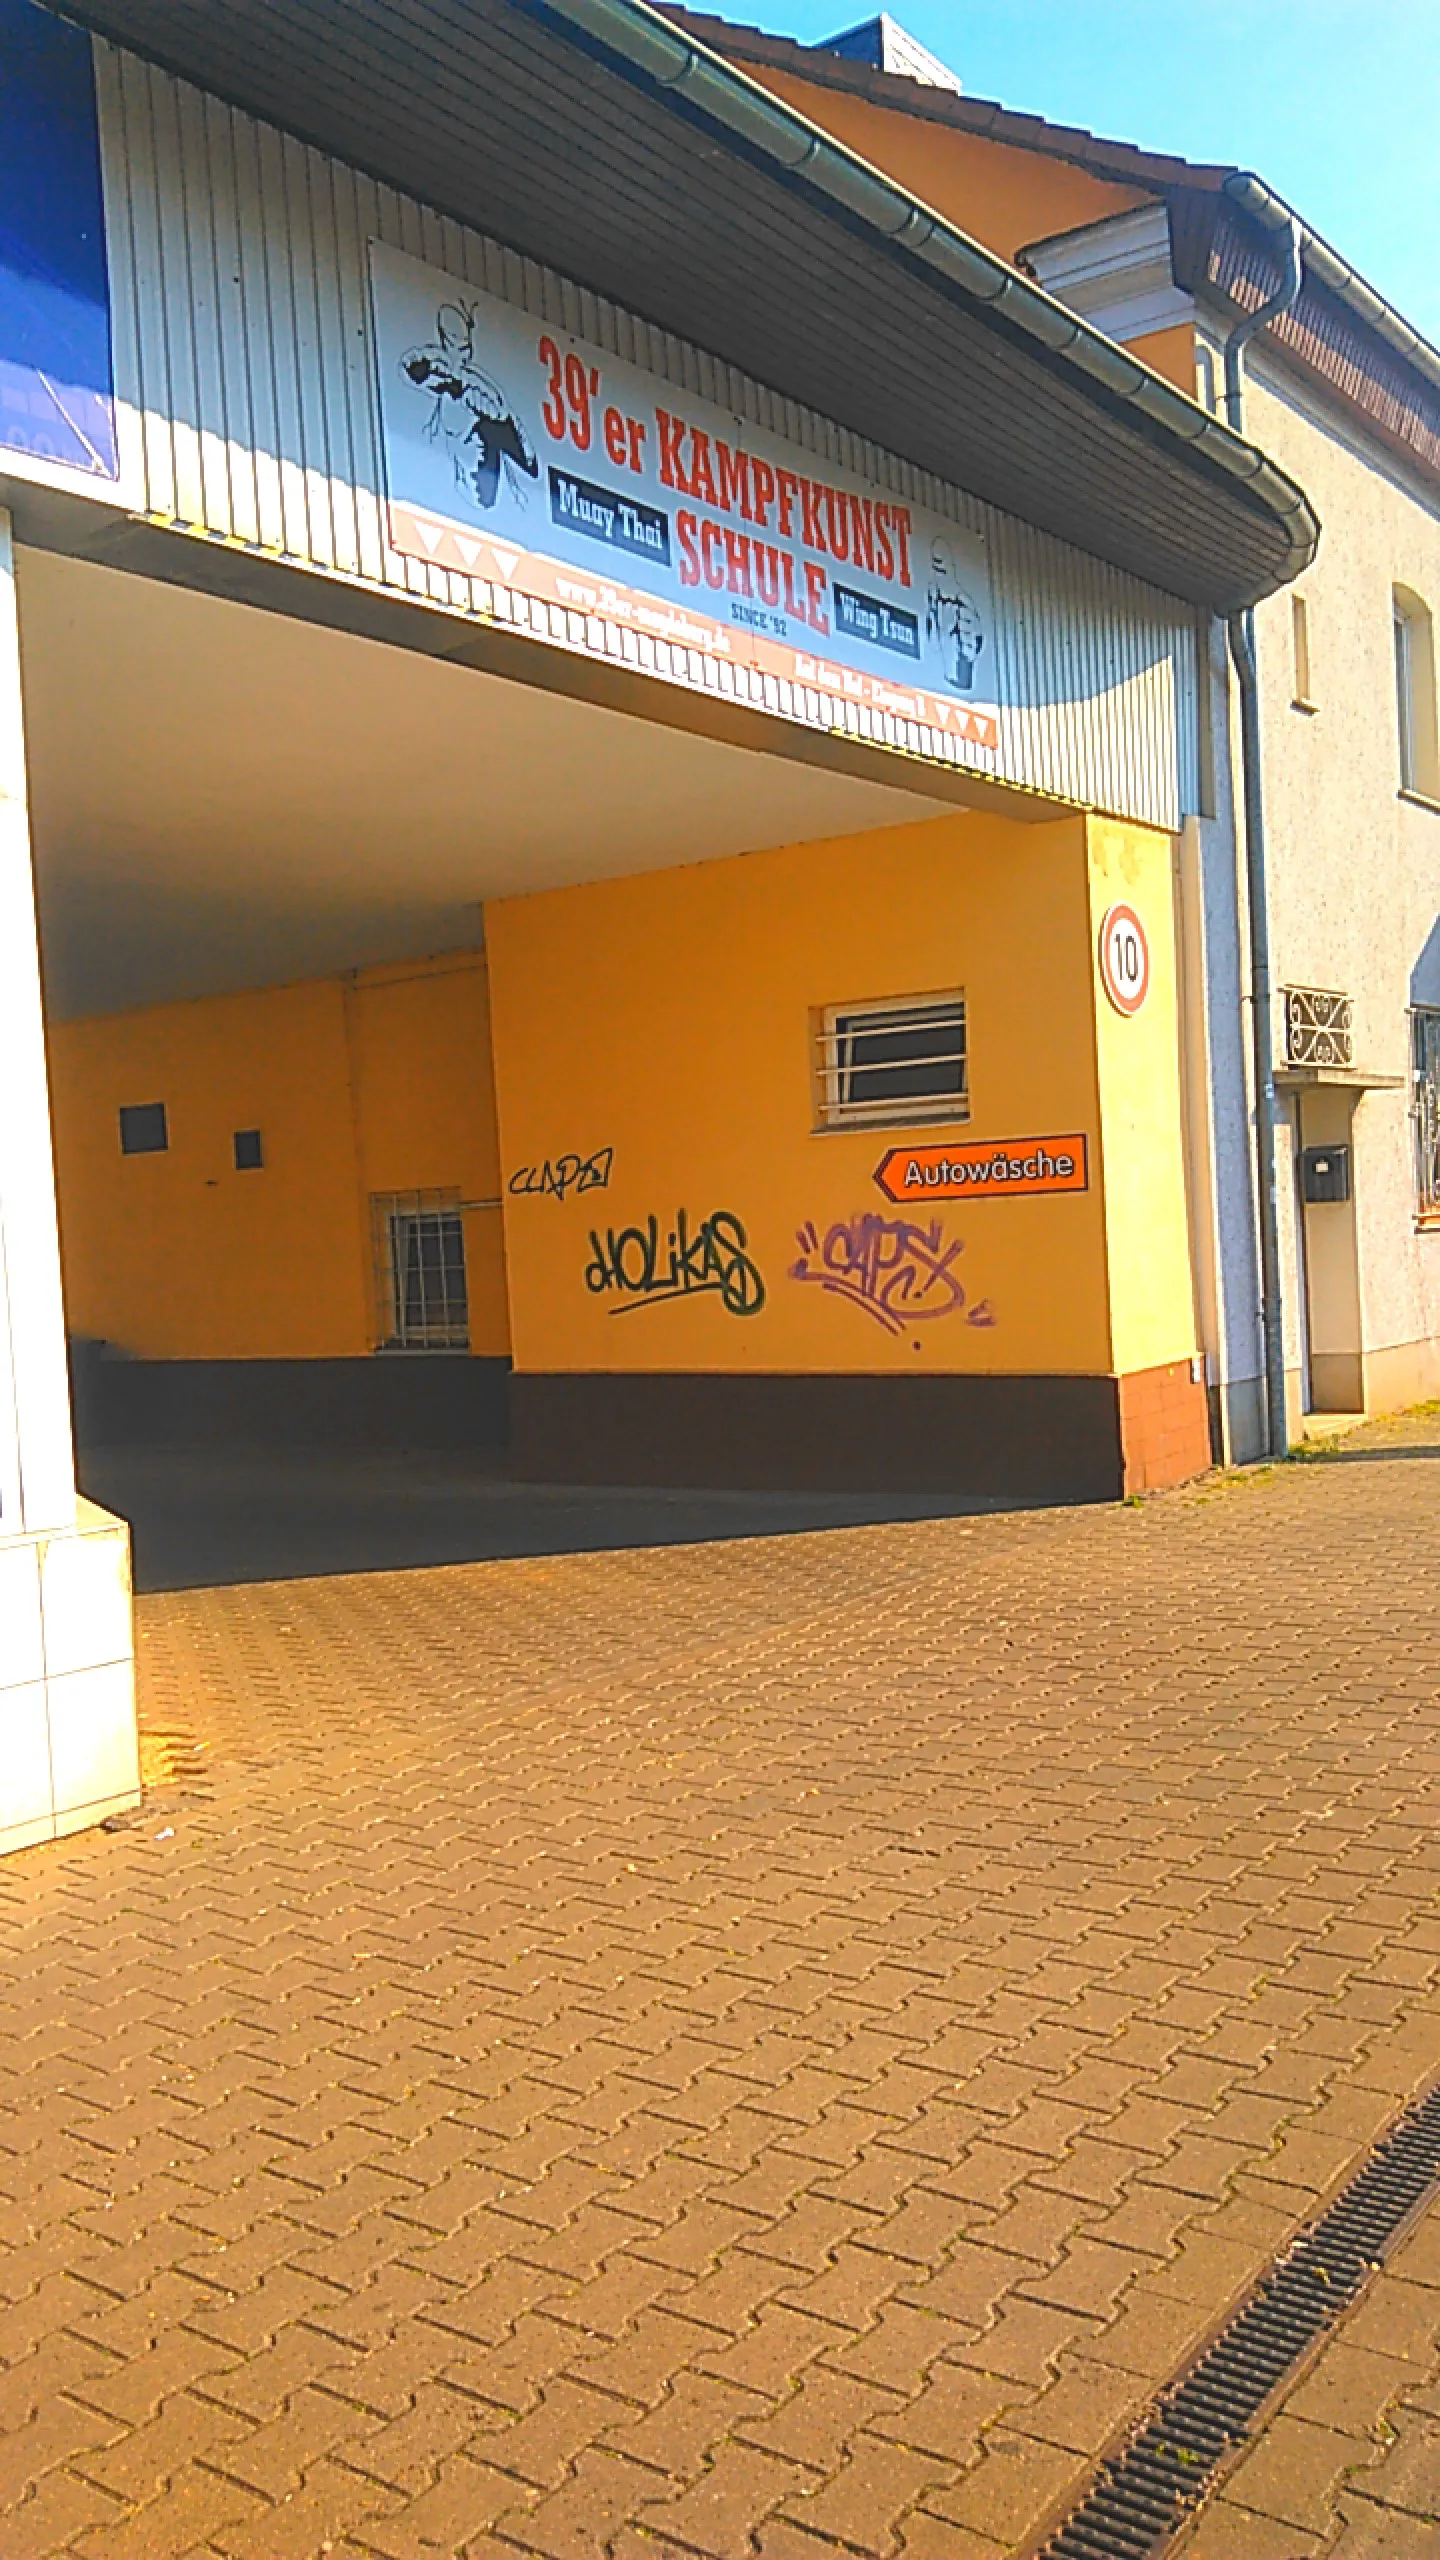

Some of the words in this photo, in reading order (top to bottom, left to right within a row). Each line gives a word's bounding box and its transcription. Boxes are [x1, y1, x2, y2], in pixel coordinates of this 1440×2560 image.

[557, 478, 614, 538] Muay
[618, 503, 663, 550] Thai
[655, 407, 912, 588] KAMPFKUNST
[676, 509, 830, 637] SCHULE
[731, 602, 768, 630] SINCE
[839, 592, 878, 638] Wing
[1114, 933, 1138, 982] 10
[903, 1149, 1074, 1188] Autowäsche
